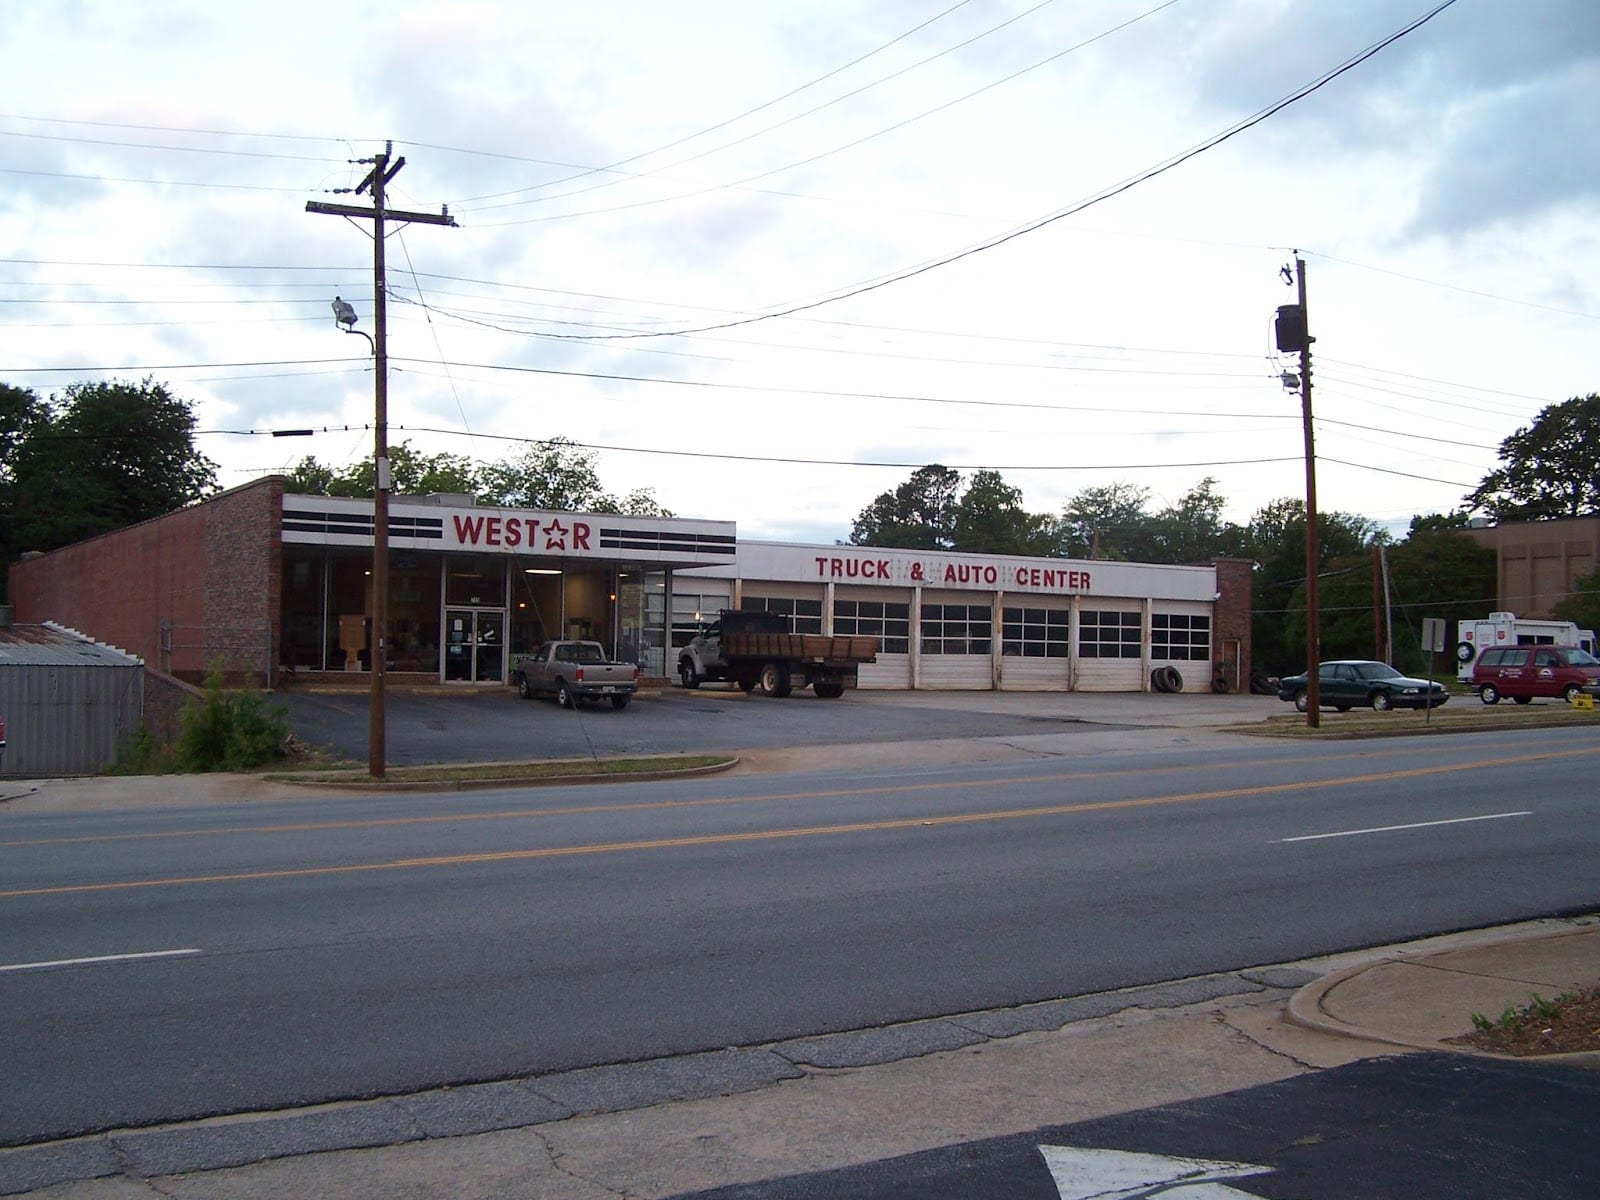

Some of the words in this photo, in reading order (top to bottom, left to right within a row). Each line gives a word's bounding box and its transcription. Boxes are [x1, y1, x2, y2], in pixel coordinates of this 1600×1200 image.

[815, 557, 890, 580] TRUCK
[910, 562, 924, 581] &
[944, 564, 997, 584] AUTO
[1016, 567, 1091, 590] CENTER
